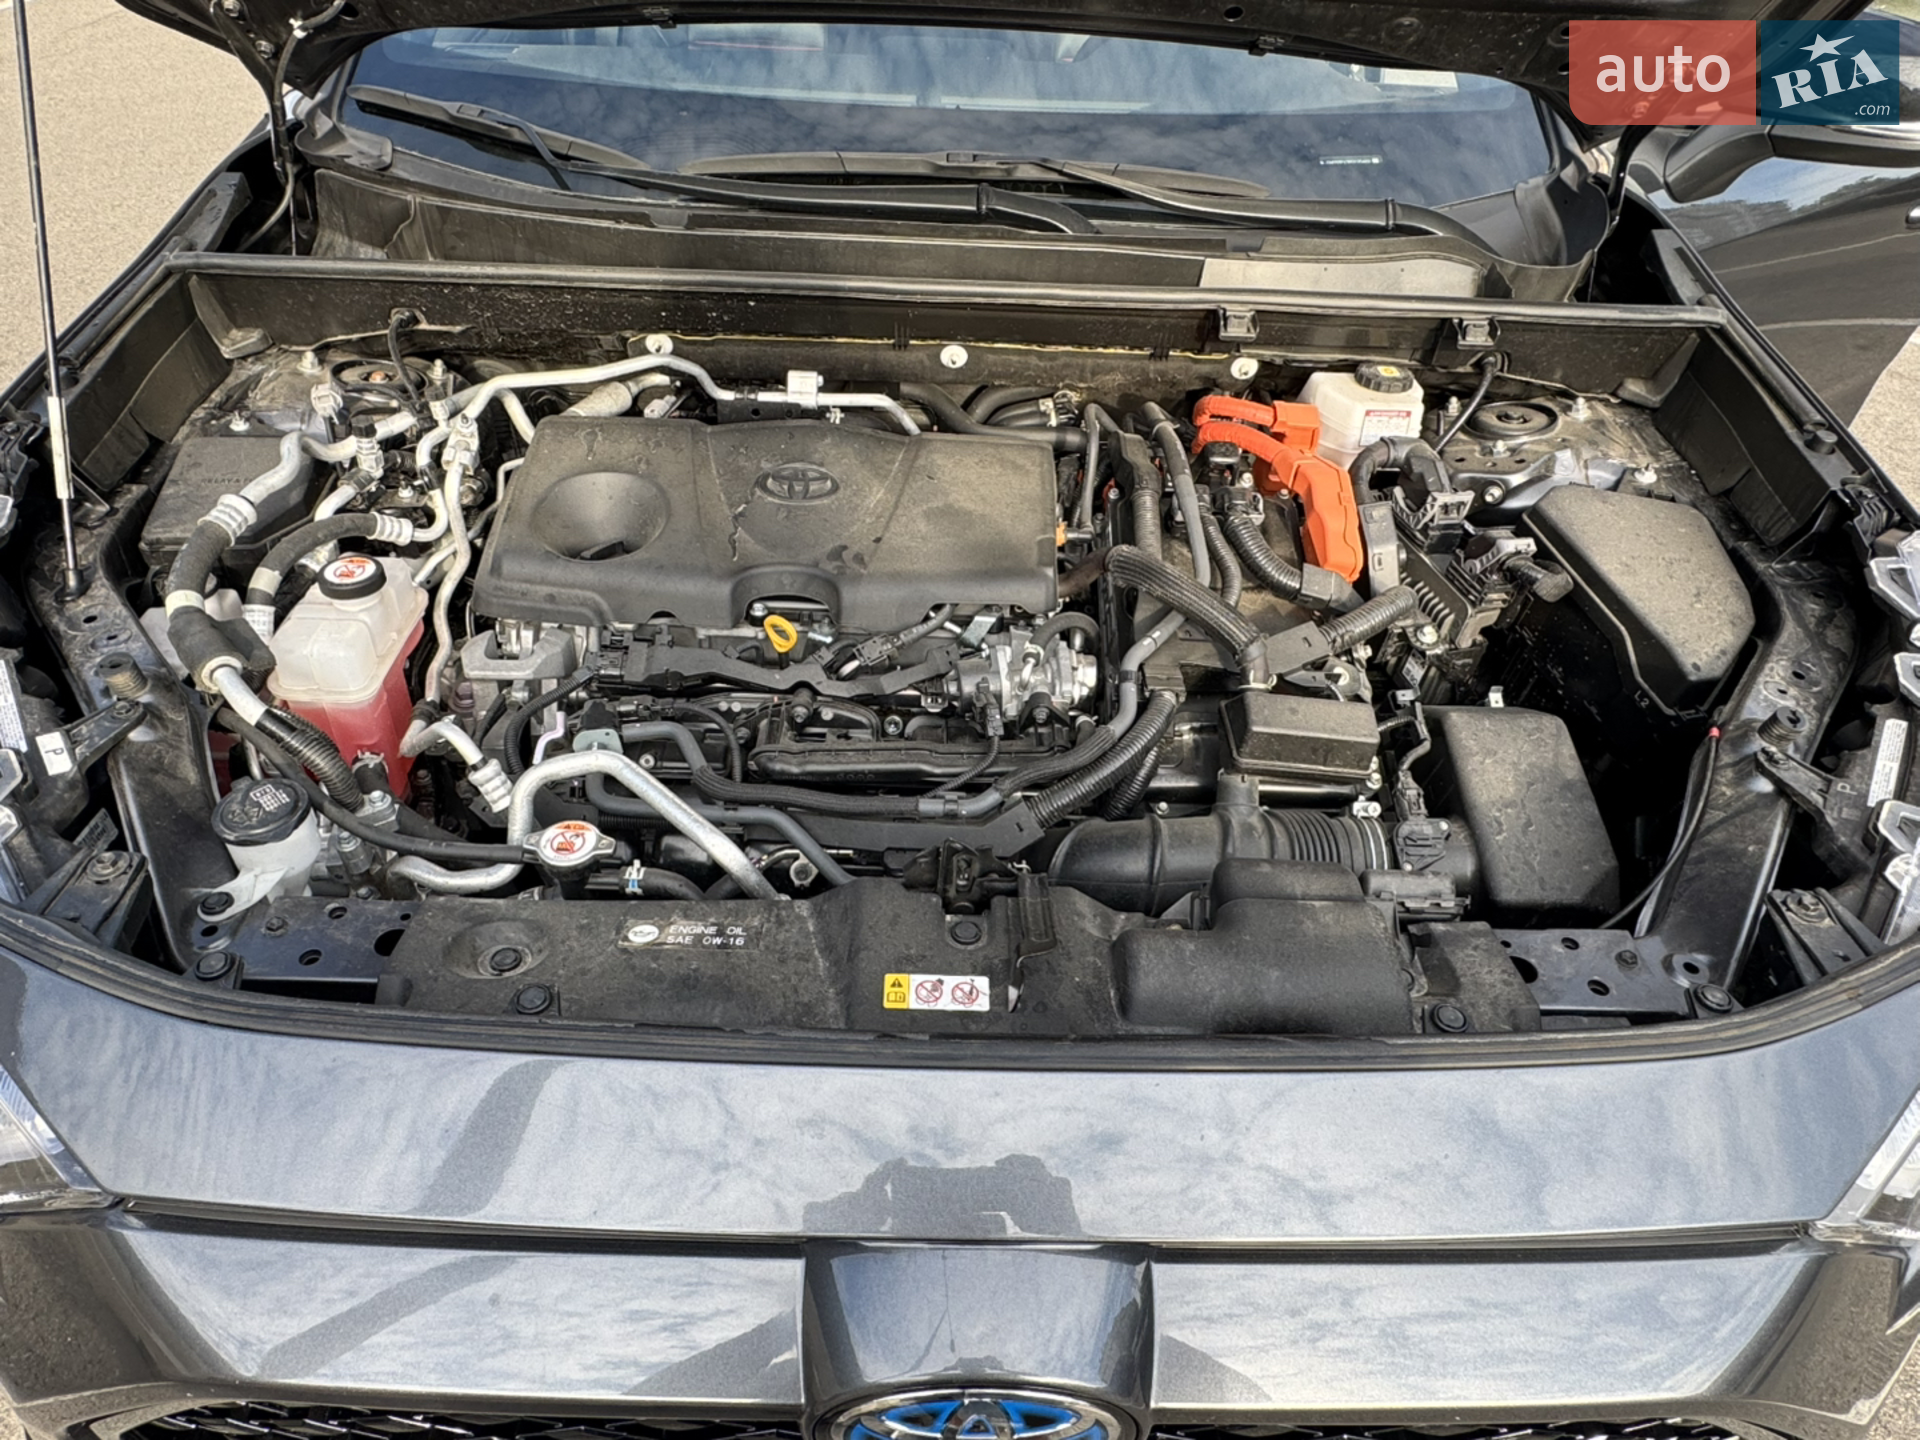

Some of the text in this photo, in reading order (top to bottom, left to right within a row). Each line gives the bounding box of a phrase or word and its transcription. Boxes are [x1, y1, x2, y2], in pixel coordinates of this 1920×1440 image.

[669, 925, 747, 935] ENGINE OIL
[666, 936, 693, 944] SAE
